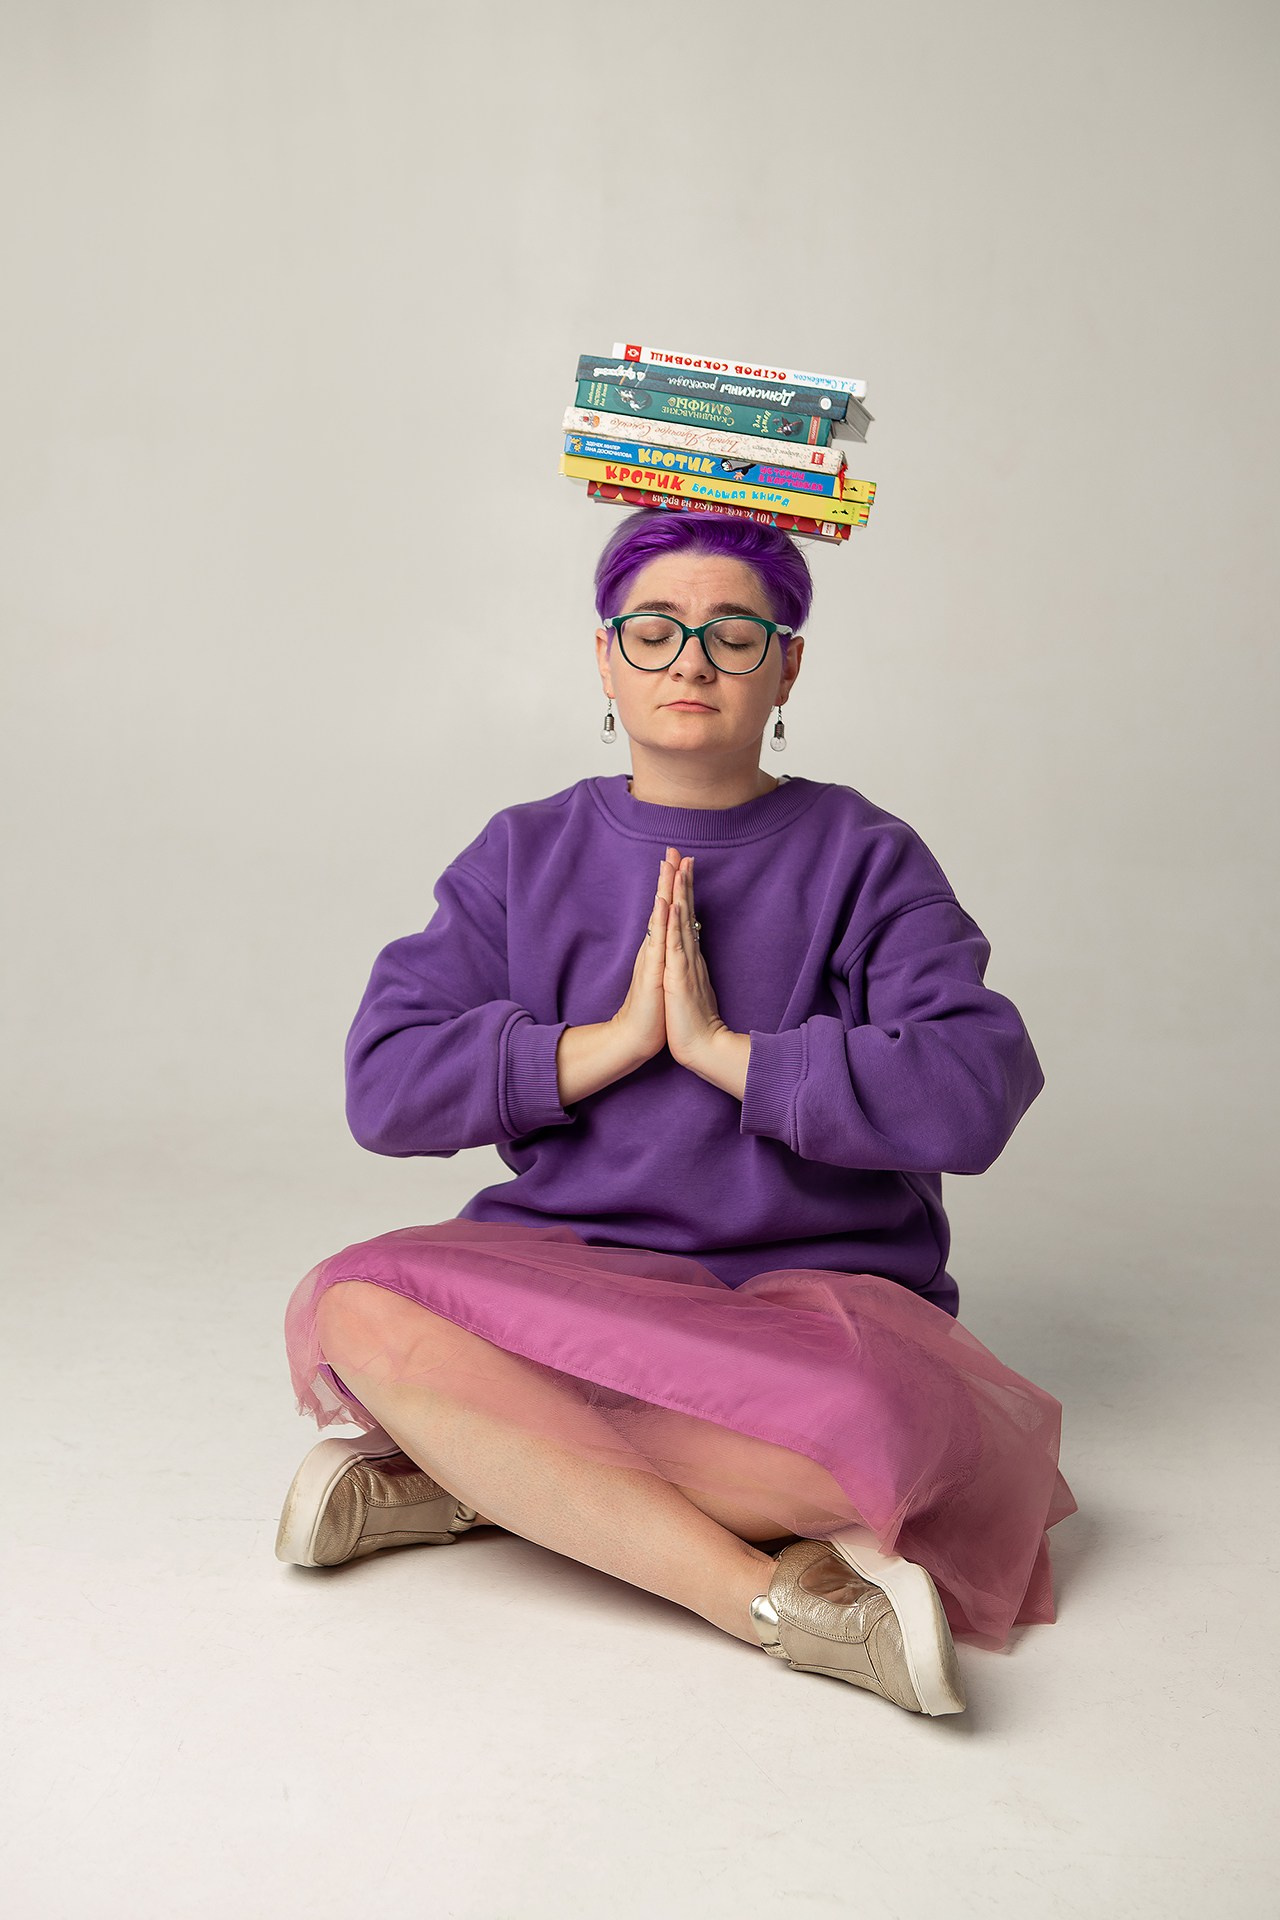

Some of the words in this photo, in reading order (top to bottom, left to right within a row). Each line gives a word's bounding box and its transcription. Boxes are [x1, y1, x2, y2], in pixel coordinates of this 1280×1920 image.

[650, 351, 729, 372] СОКРОВИЩ
[734, 365, 787, 381] ОСТРОВ
[793, 373, 838, 388] Стивенсон
[667, 376, 719, 390] рассказы
[720, 383, 797, 407] Денискины
[675, 397, 723, 414] МИФЫ
[637, 448, 716, 474] КРОТИК
[605, 465, 686, 491] КРОТИК
[759, 465, 805, 481] ИСТОРИИ
[766, 475, 824, 492] КАРТИНКАХ
[652, 494, 679, 507] время
[691, 483, 746, 499] БОЛЬШАЯ
[751, 490, 790, 508] КНИГА
[681, 500, 692, 508] на
[756, 514, 770, 524] 101
